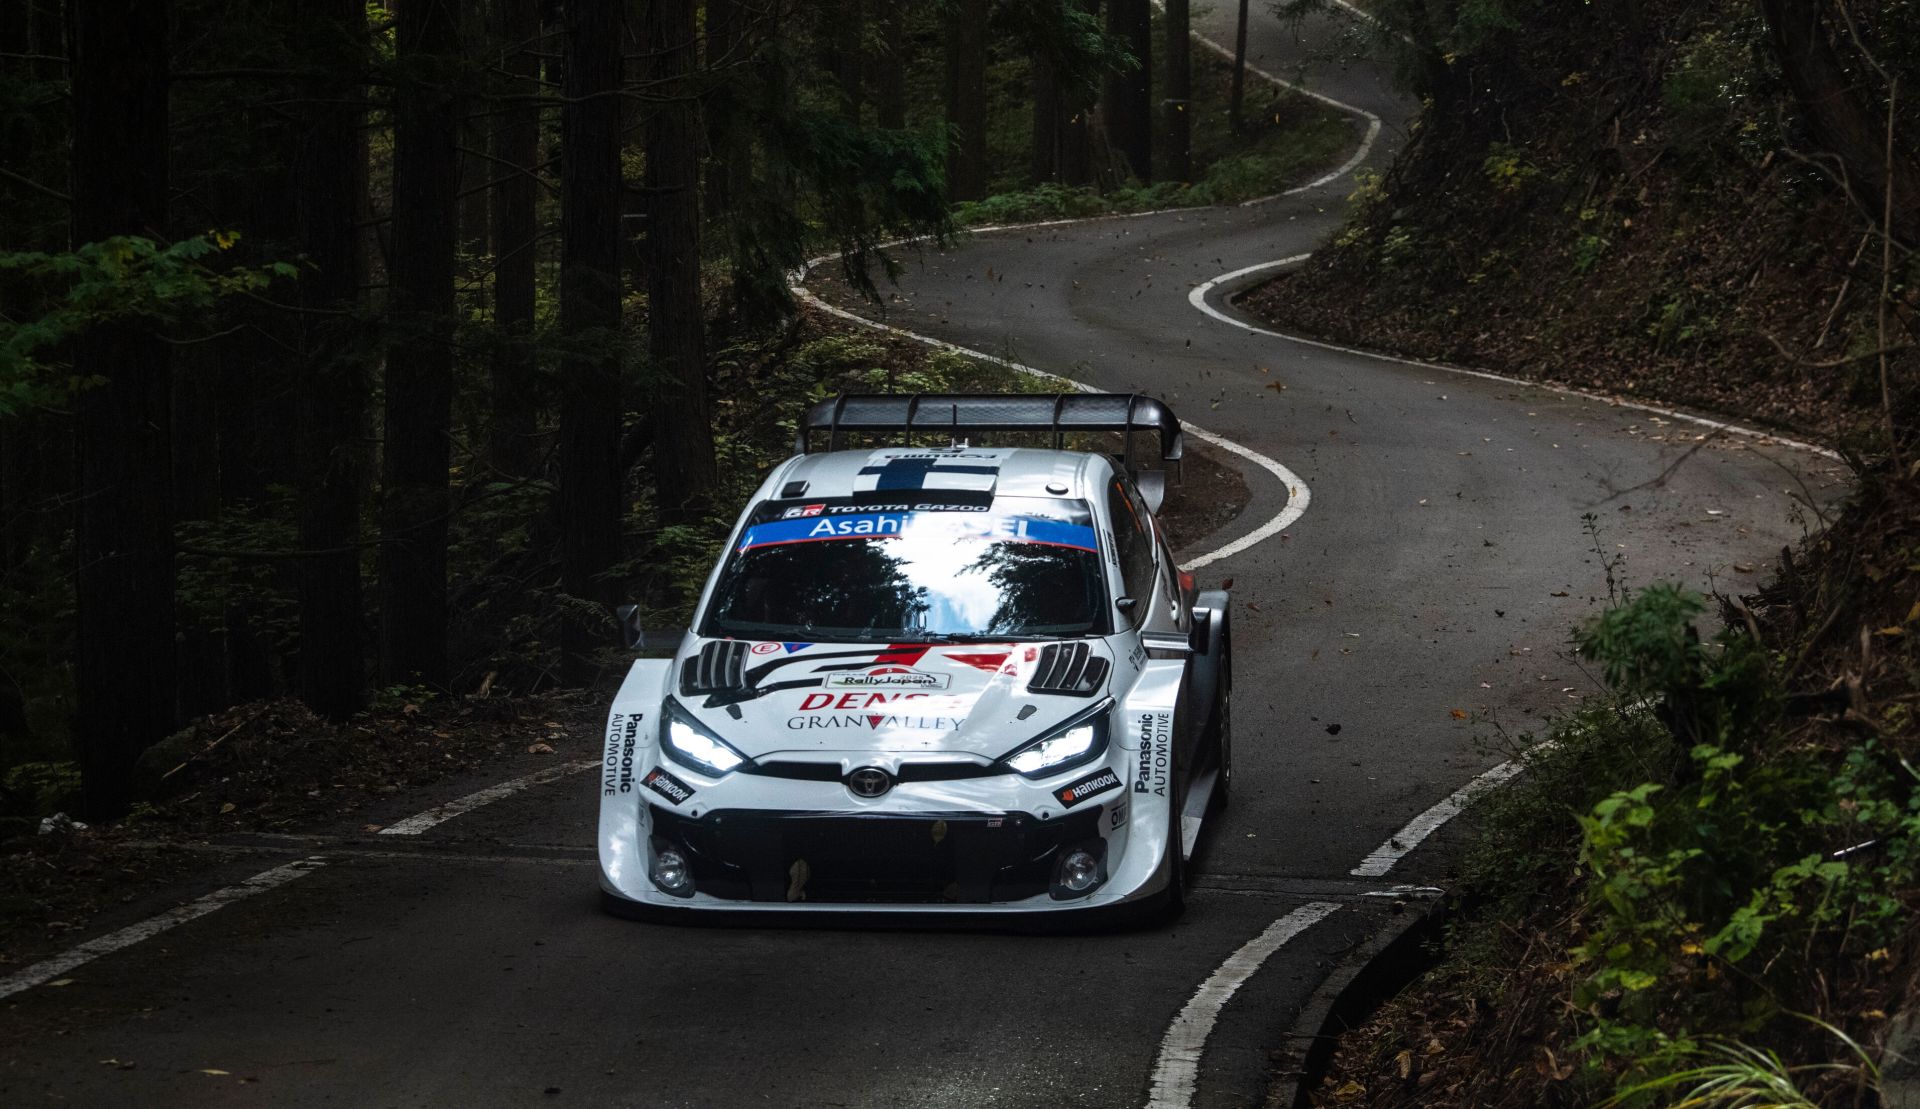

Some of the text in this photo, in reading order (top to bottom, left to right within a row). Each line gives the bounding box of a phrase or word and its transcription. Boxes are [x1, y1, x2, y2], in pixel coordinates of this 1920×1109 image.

[809, 514, 908, 537] Asahi
[828, 504, 909, 514] TOYOTA
[914, 503, 989, 513] GAZOO
[605, 713, 624, 797] AUTOMOTIVE
[620, 713, 644, 794] Panasonic
[1134, 713, 1153, 794] Panasonic
[1154, 713, 1169, 797] AUTOMOTIVE
